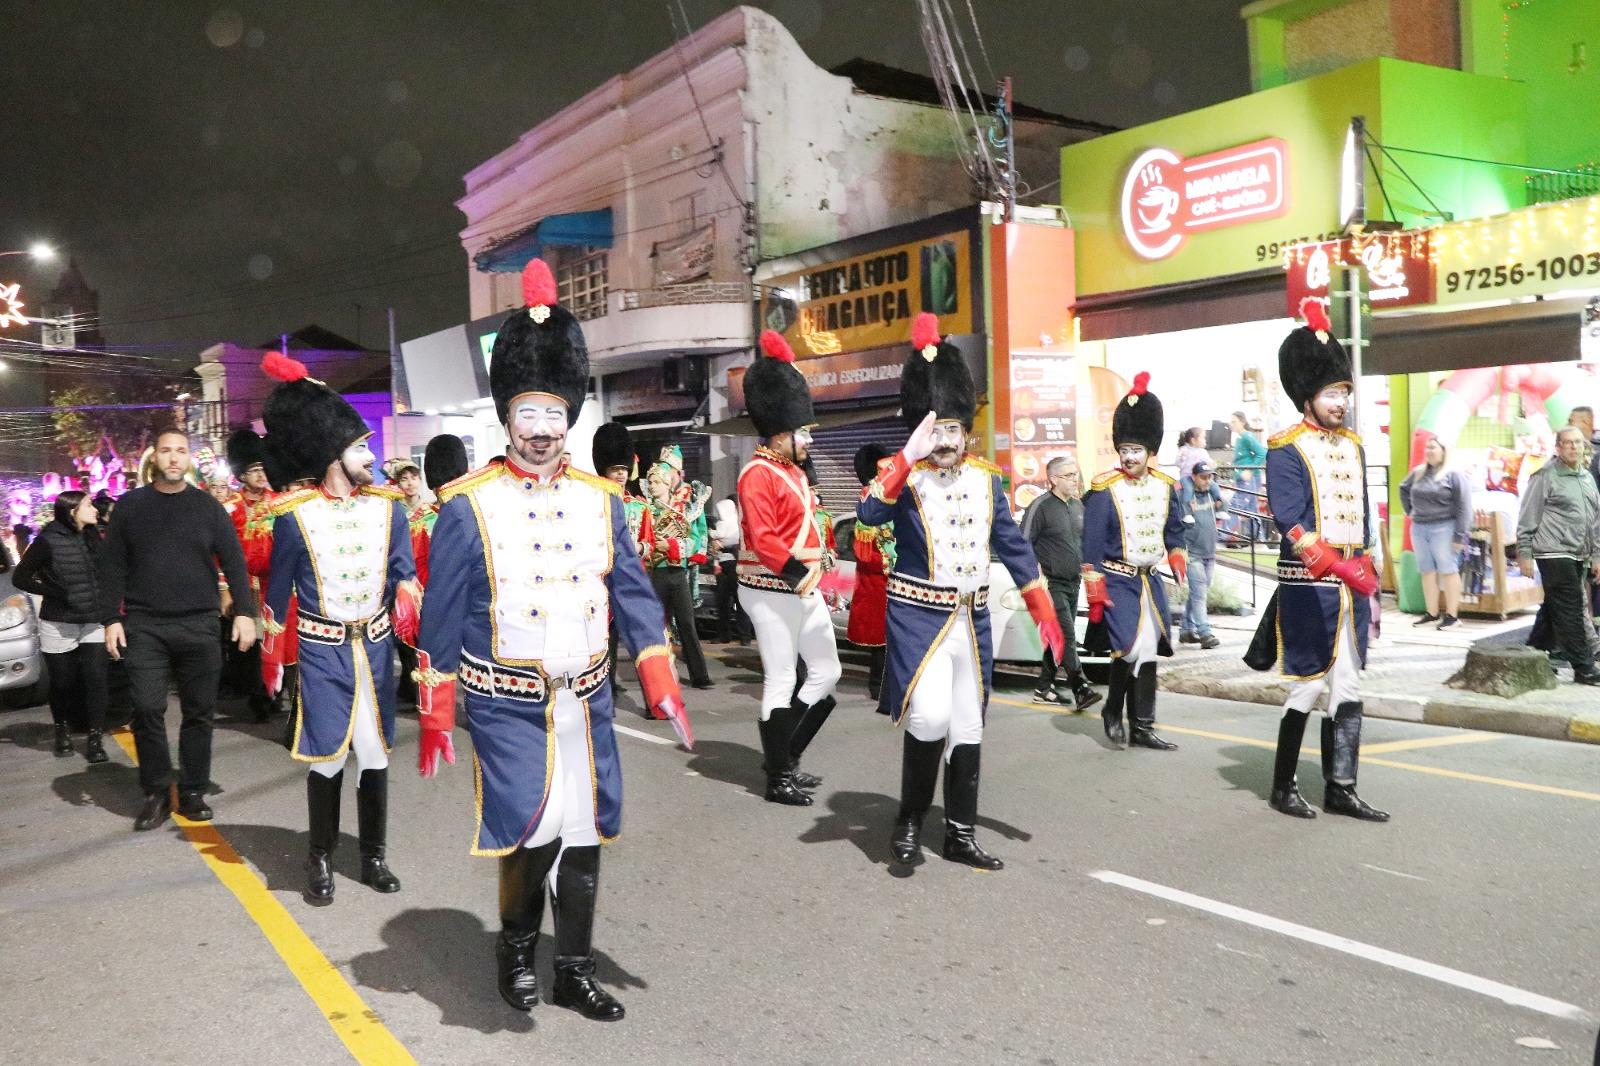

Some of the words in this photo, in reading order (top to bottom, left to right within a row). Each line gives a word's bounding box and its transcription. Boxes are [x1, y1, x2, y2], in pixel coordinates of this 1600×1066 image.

[1185, 163, 1271, 200] MIRANDELA
[863, 251, 909, 288] FOTO
[1446, 251, 1600, 293] 97256-1003
[800, 288, 910, 336] BRAGANÇA
